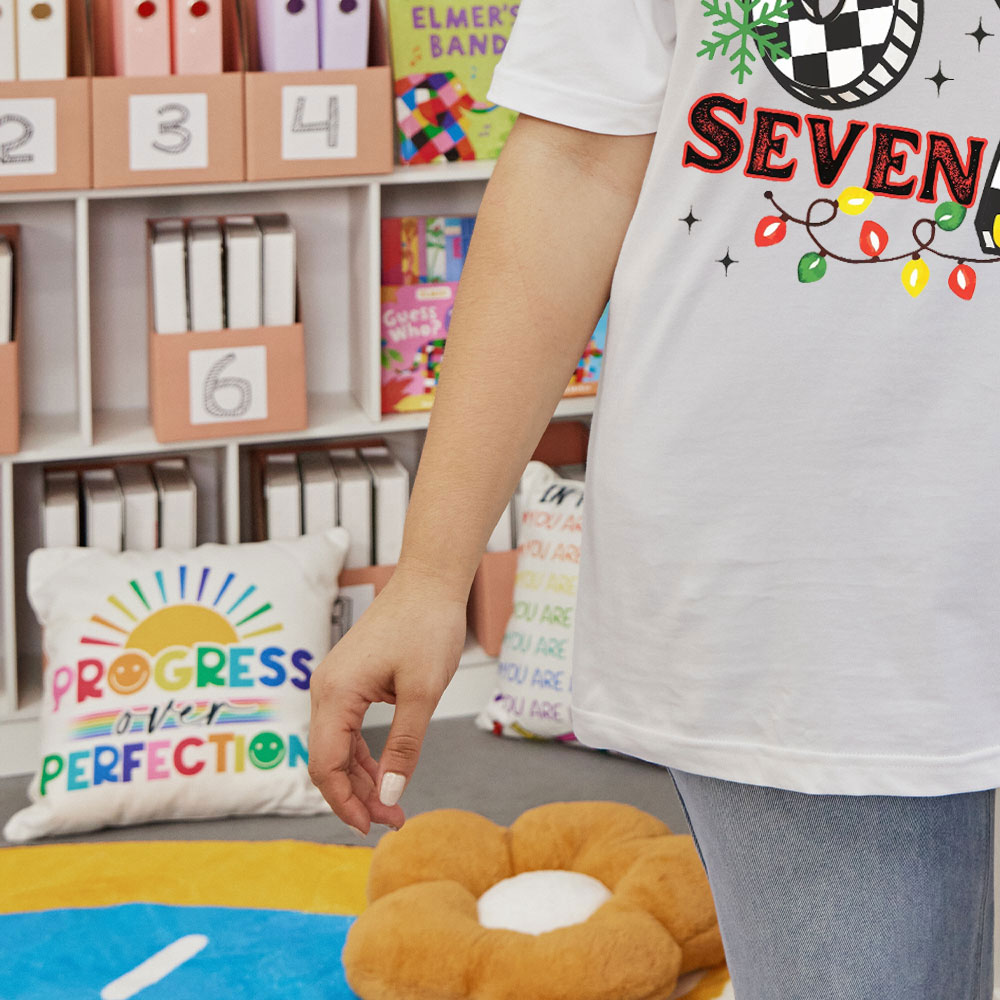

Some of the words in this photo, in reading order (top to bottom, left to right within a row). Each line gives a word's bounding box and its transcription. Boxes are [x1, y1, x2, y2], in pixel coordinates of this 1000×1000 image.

[430, 34, 509, 58] BAND
[0, 114, 34, 163] 2
[152, 102, 192, 155] 3
[291, 95, 338, 148] 4
[682, 93, 988, 207] SEVEN
[204, 353, 253, 417] 6
[53, 646, 314, 713] PROGRESS
[115, 699, 245, 735] over
